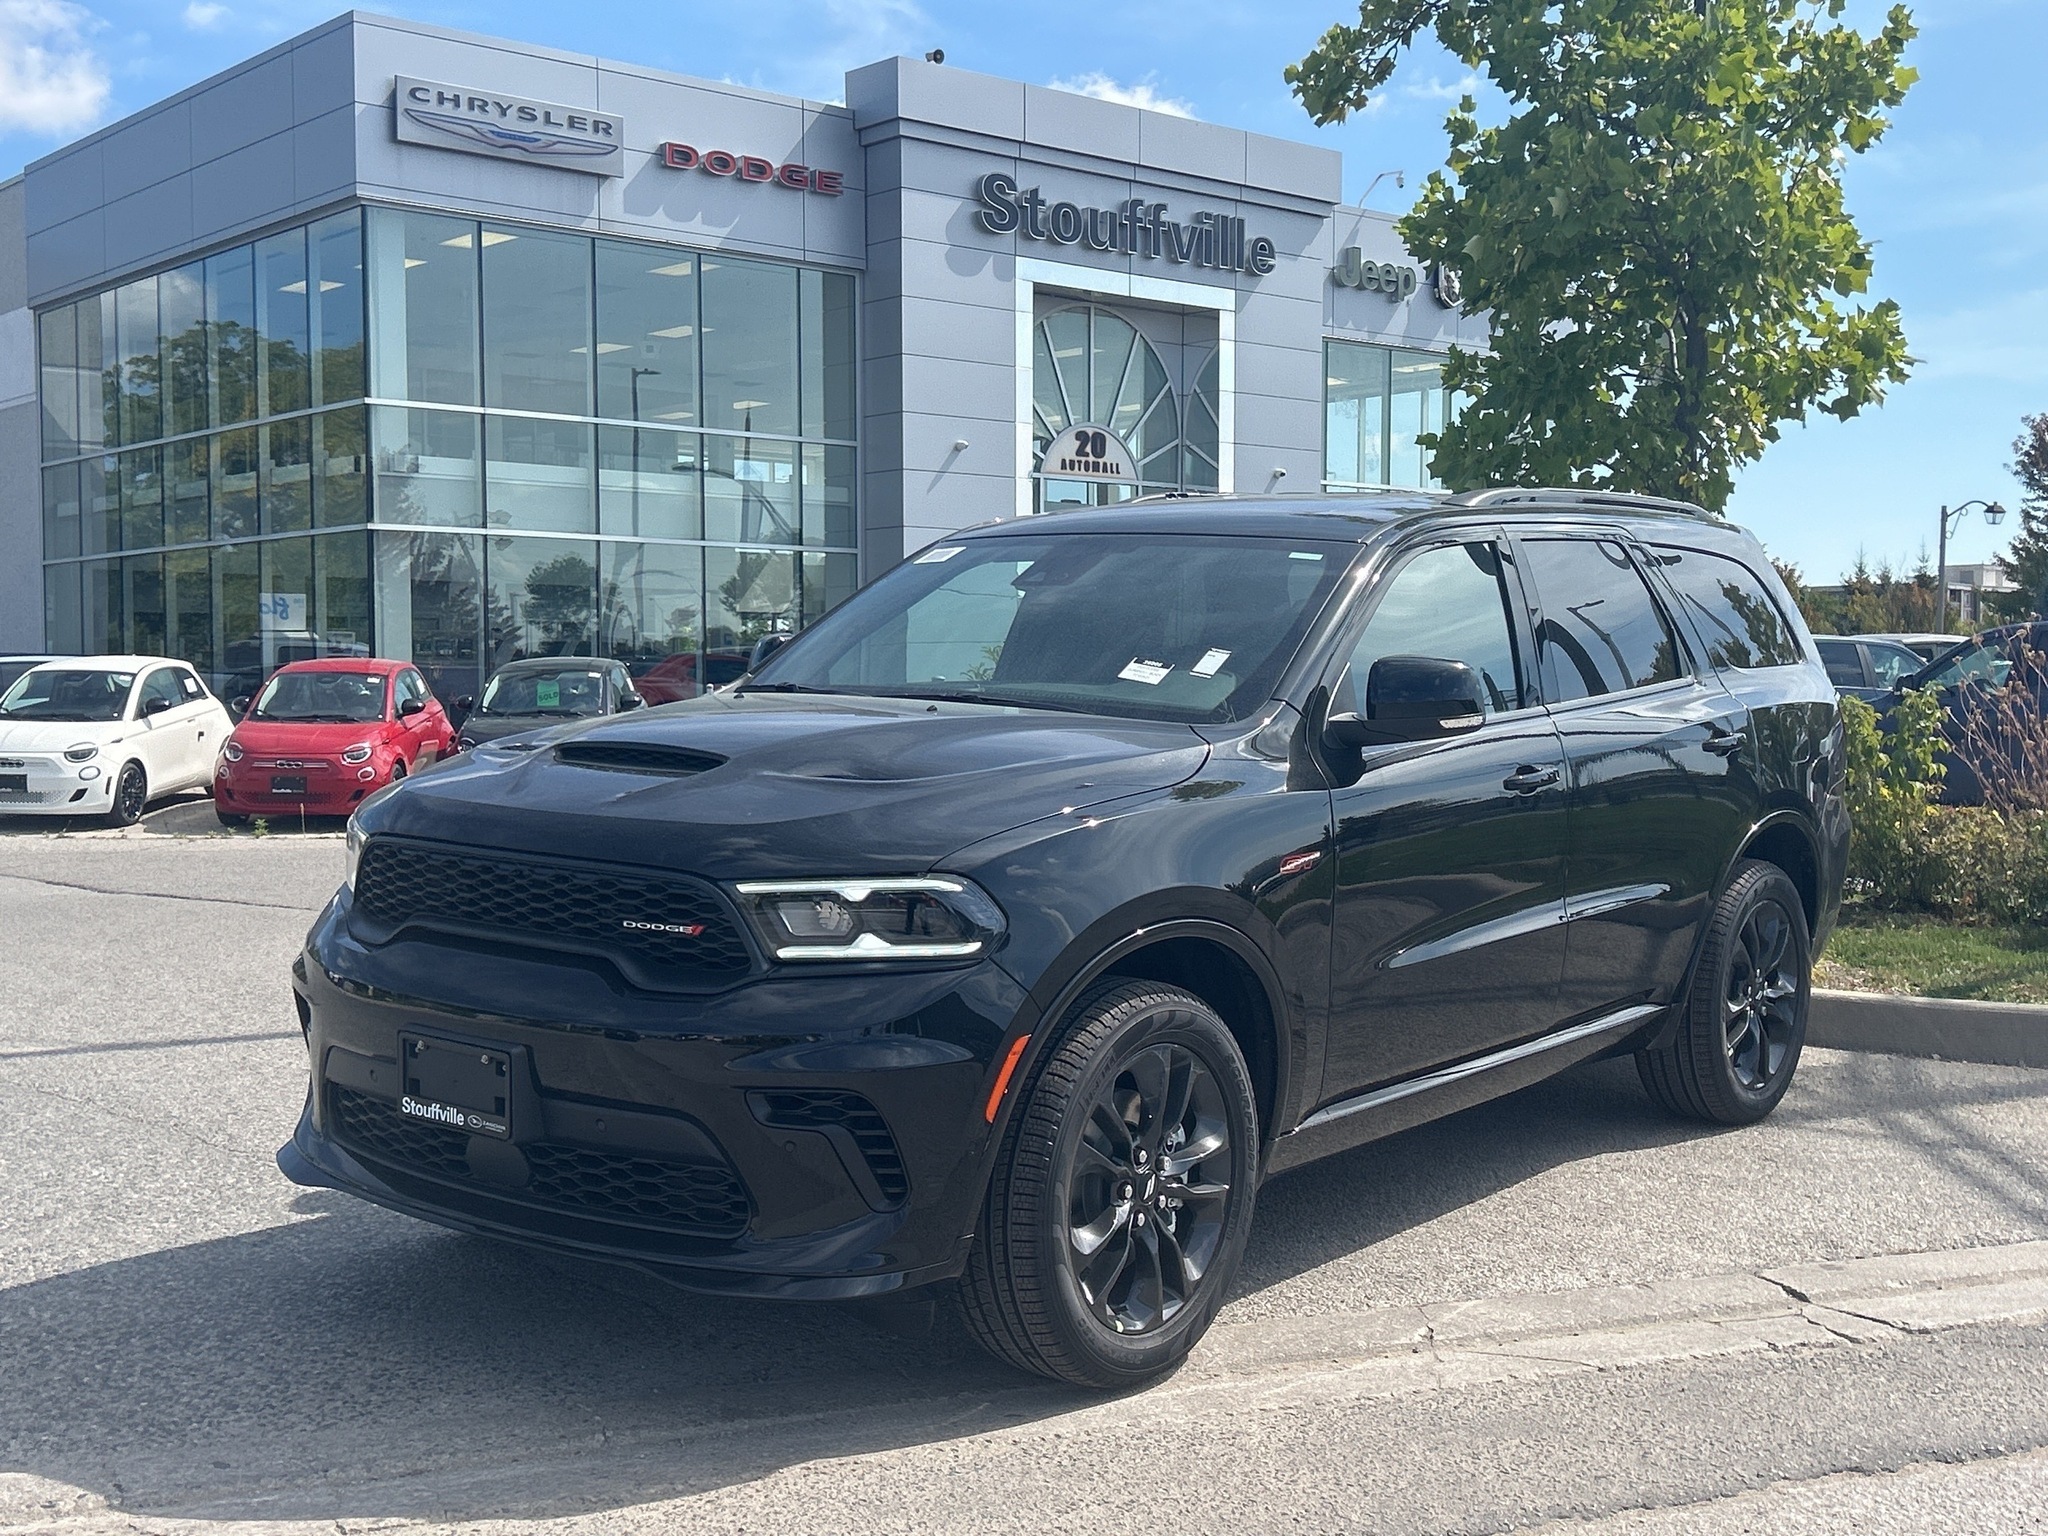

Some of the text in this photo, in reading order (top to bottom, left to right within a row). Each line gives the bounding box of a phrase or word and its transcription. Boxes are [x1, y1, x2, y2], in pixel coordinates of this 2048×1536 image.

[408, 86, 614, 136] CHRYSLER
[661, 142, 844, 195] DODGE
[977, 173, 1277, 276] Stouffville
[1335, 246, 1416, 302] Jeep
[1075, 430, 1106, 459] 20
[1060, 458, 1121, 475] AUTOMALL
[538, 691, 559, 702] SOLD
[623, 920, 693, 935] DODGE
[402, 1096, 465, 1126] Stouffville
